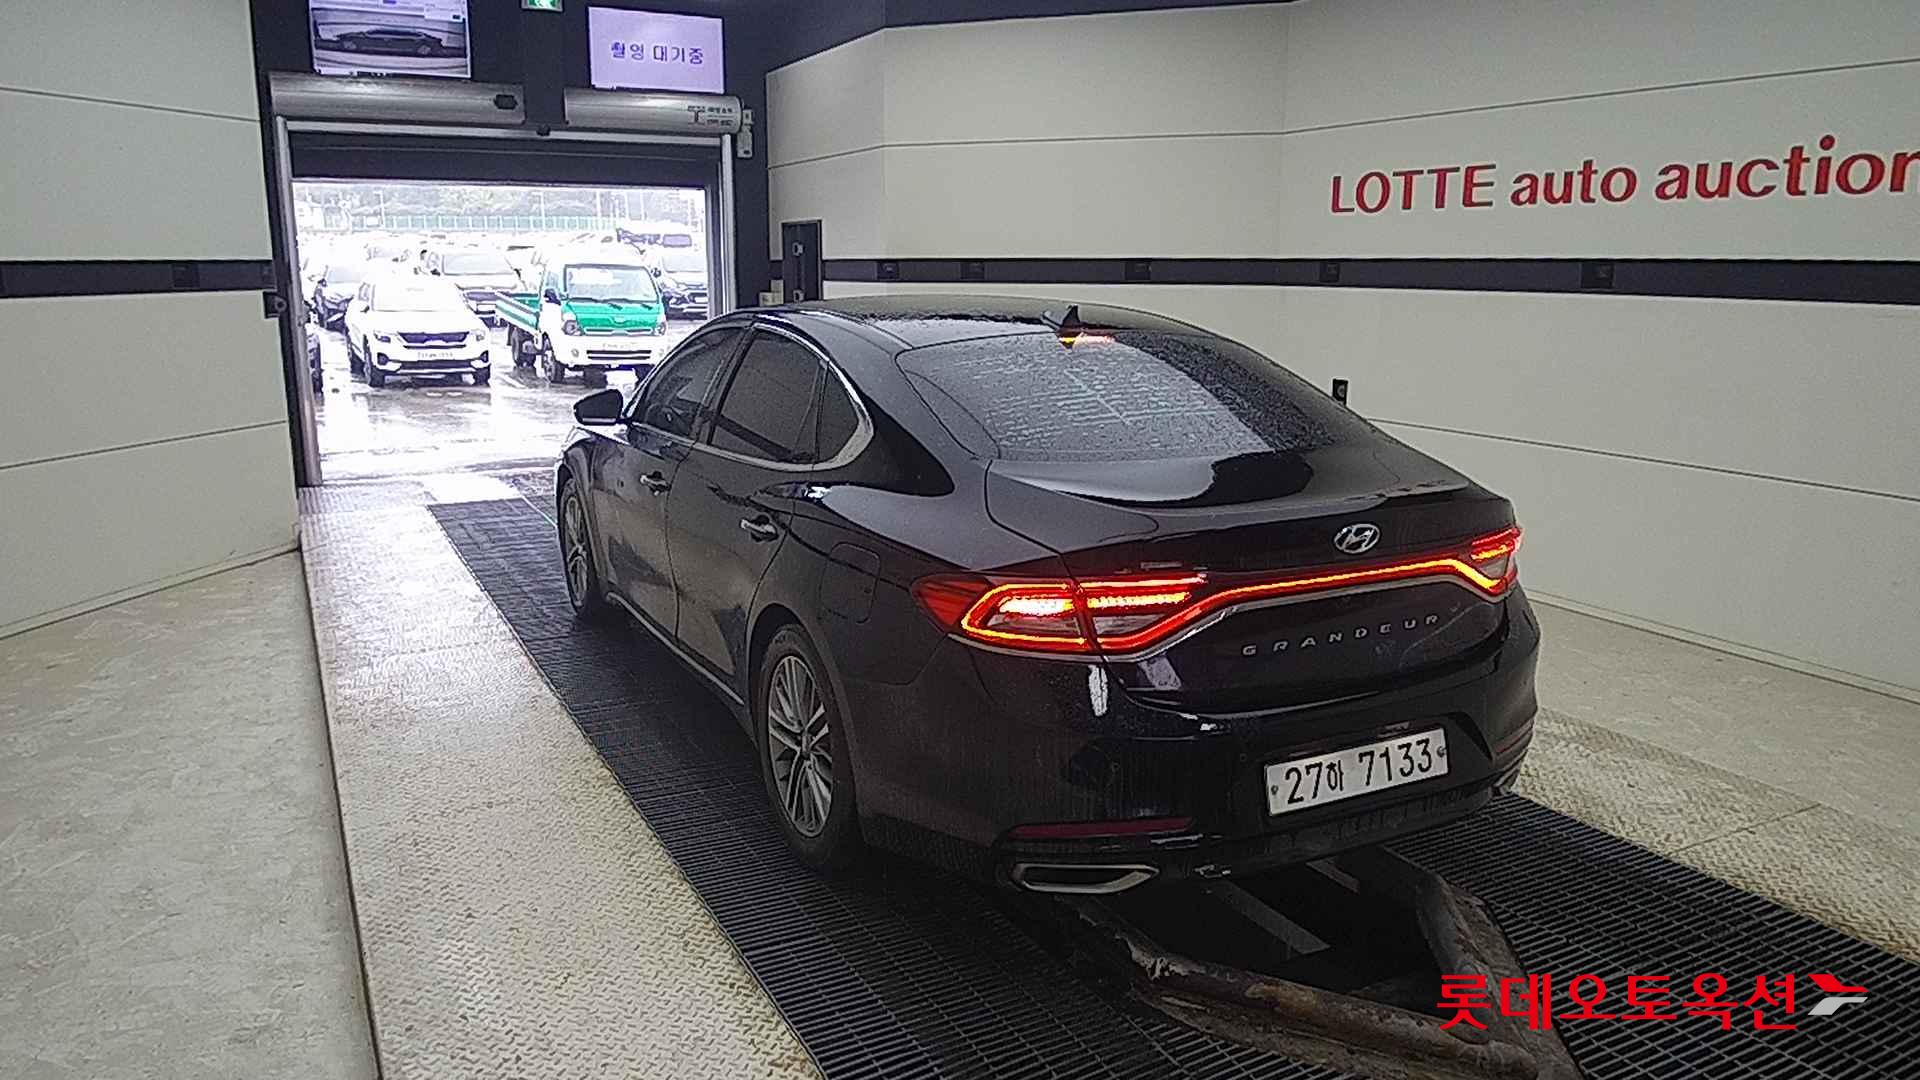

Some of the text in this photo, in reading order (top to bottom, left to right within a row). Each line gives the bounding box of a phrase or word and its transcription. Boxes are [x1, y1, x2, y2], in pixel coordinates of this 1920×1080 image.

[653, 45, 704, 65] 대기중
[1331, 163, 1497, 214] LOTTE
[1510, 158, 1638, 207] auto
[1241, 614, 1439, 656] GRANDEUR
[1284, 738, 1433, 805] 27하 7133
